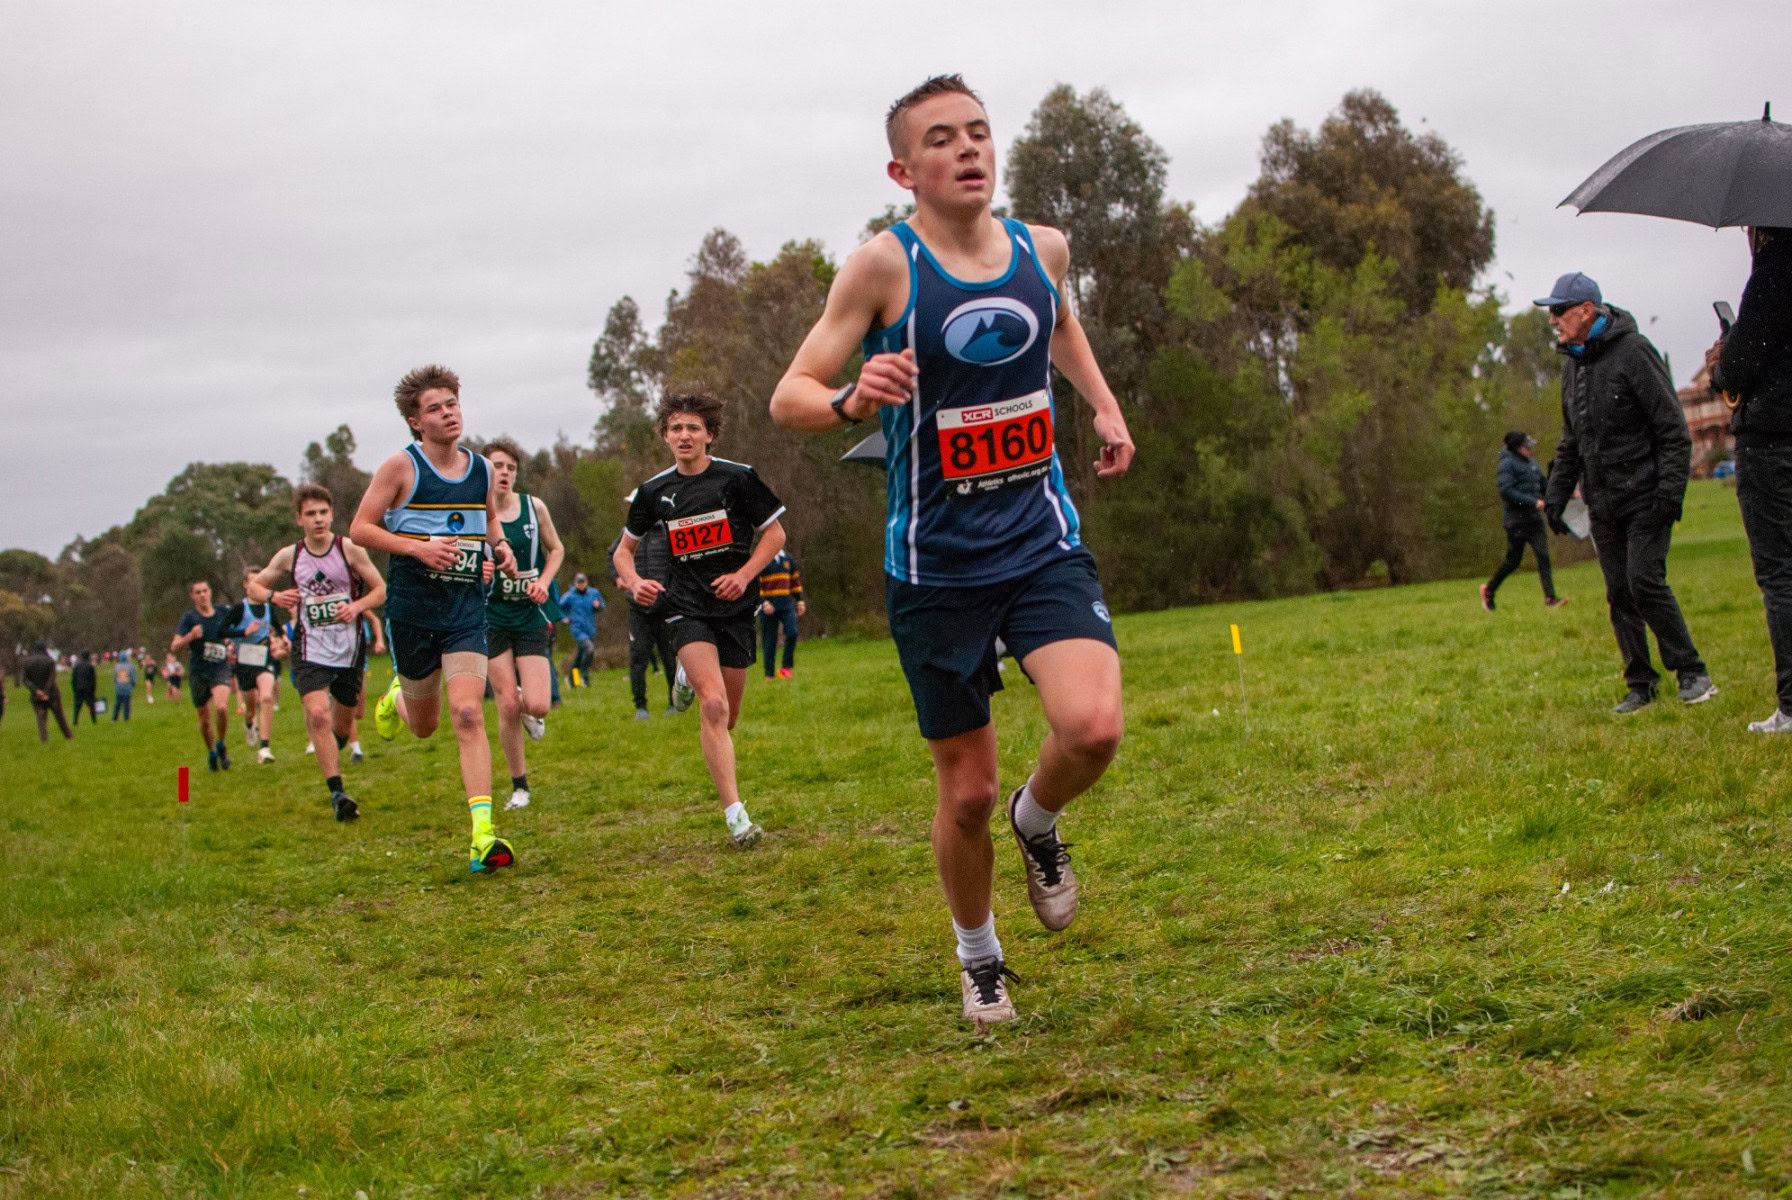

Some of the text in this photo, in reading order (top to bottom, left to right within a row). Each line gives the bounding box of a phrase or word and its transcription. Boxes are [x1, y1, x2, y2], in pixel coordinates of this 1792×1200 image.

[963, 400, 1033, 422] XCR SCHOOLS
[949, 416, 1047, 470] 8160
[977, 478, 1004, 488] Athletics
[675, 522, 724, 550] 8127
[309, 601, 346, 620] 919
